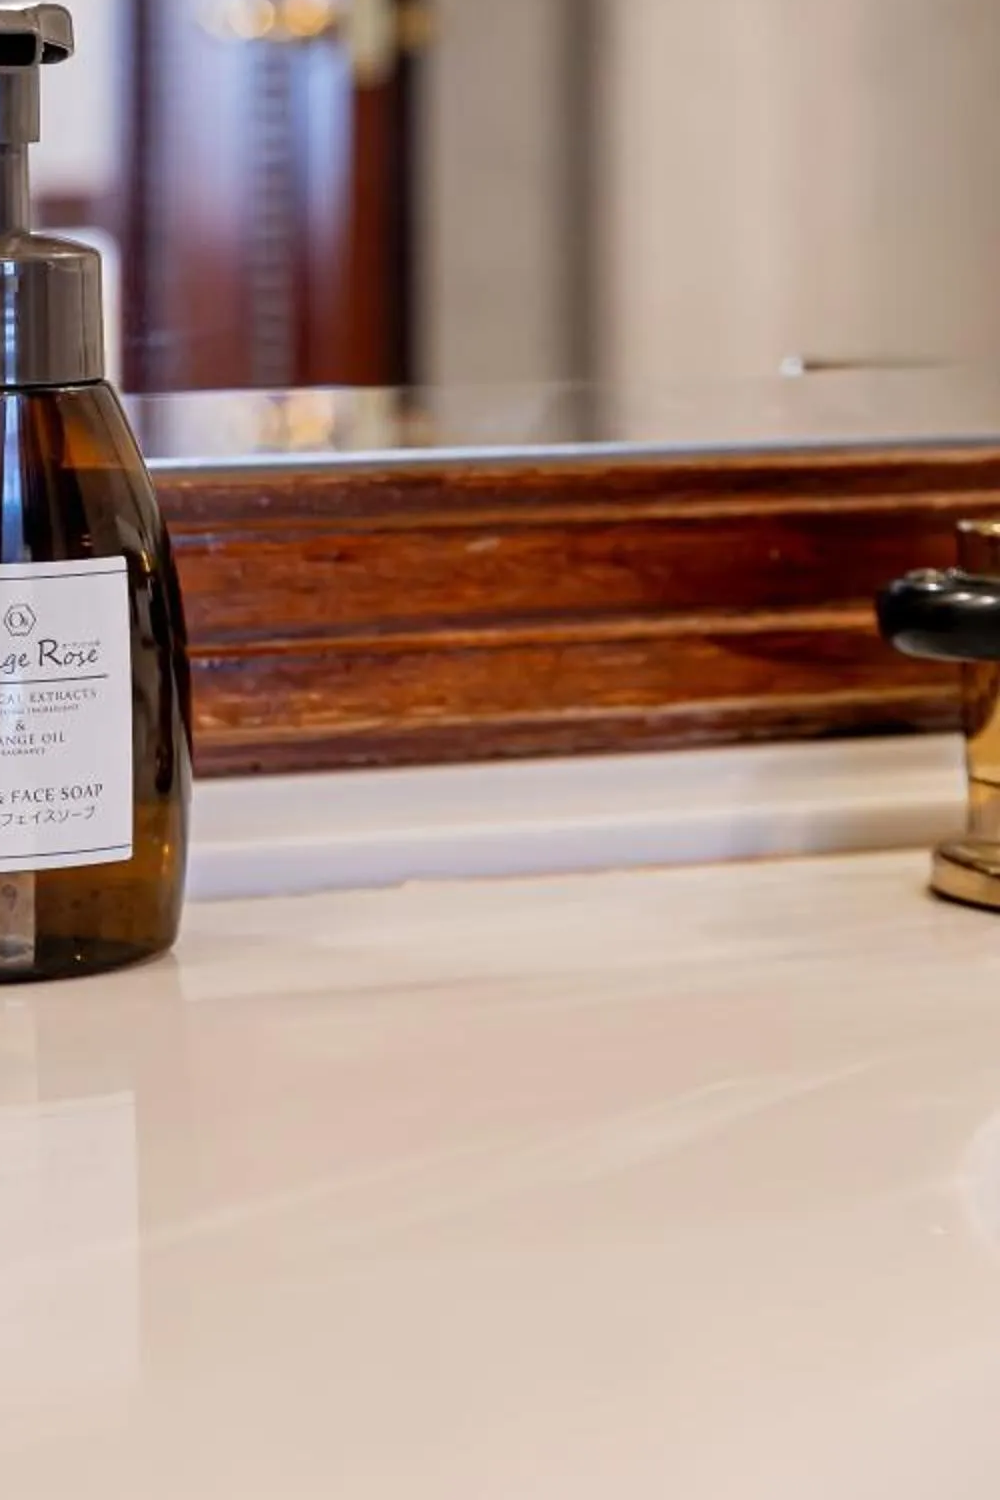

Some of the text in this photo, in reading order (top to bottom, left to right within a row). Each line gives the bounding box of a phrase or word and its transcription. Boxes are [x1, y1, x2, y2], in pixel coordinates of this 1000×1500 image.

[37, 638, 99, 668] Rose
[29, 688, 98, 704] EXTRACTS
[40, 730, 66, 744] OIL
[11, 786, 55, 803] FACE
[60, 783, 104, 801] SOAP
